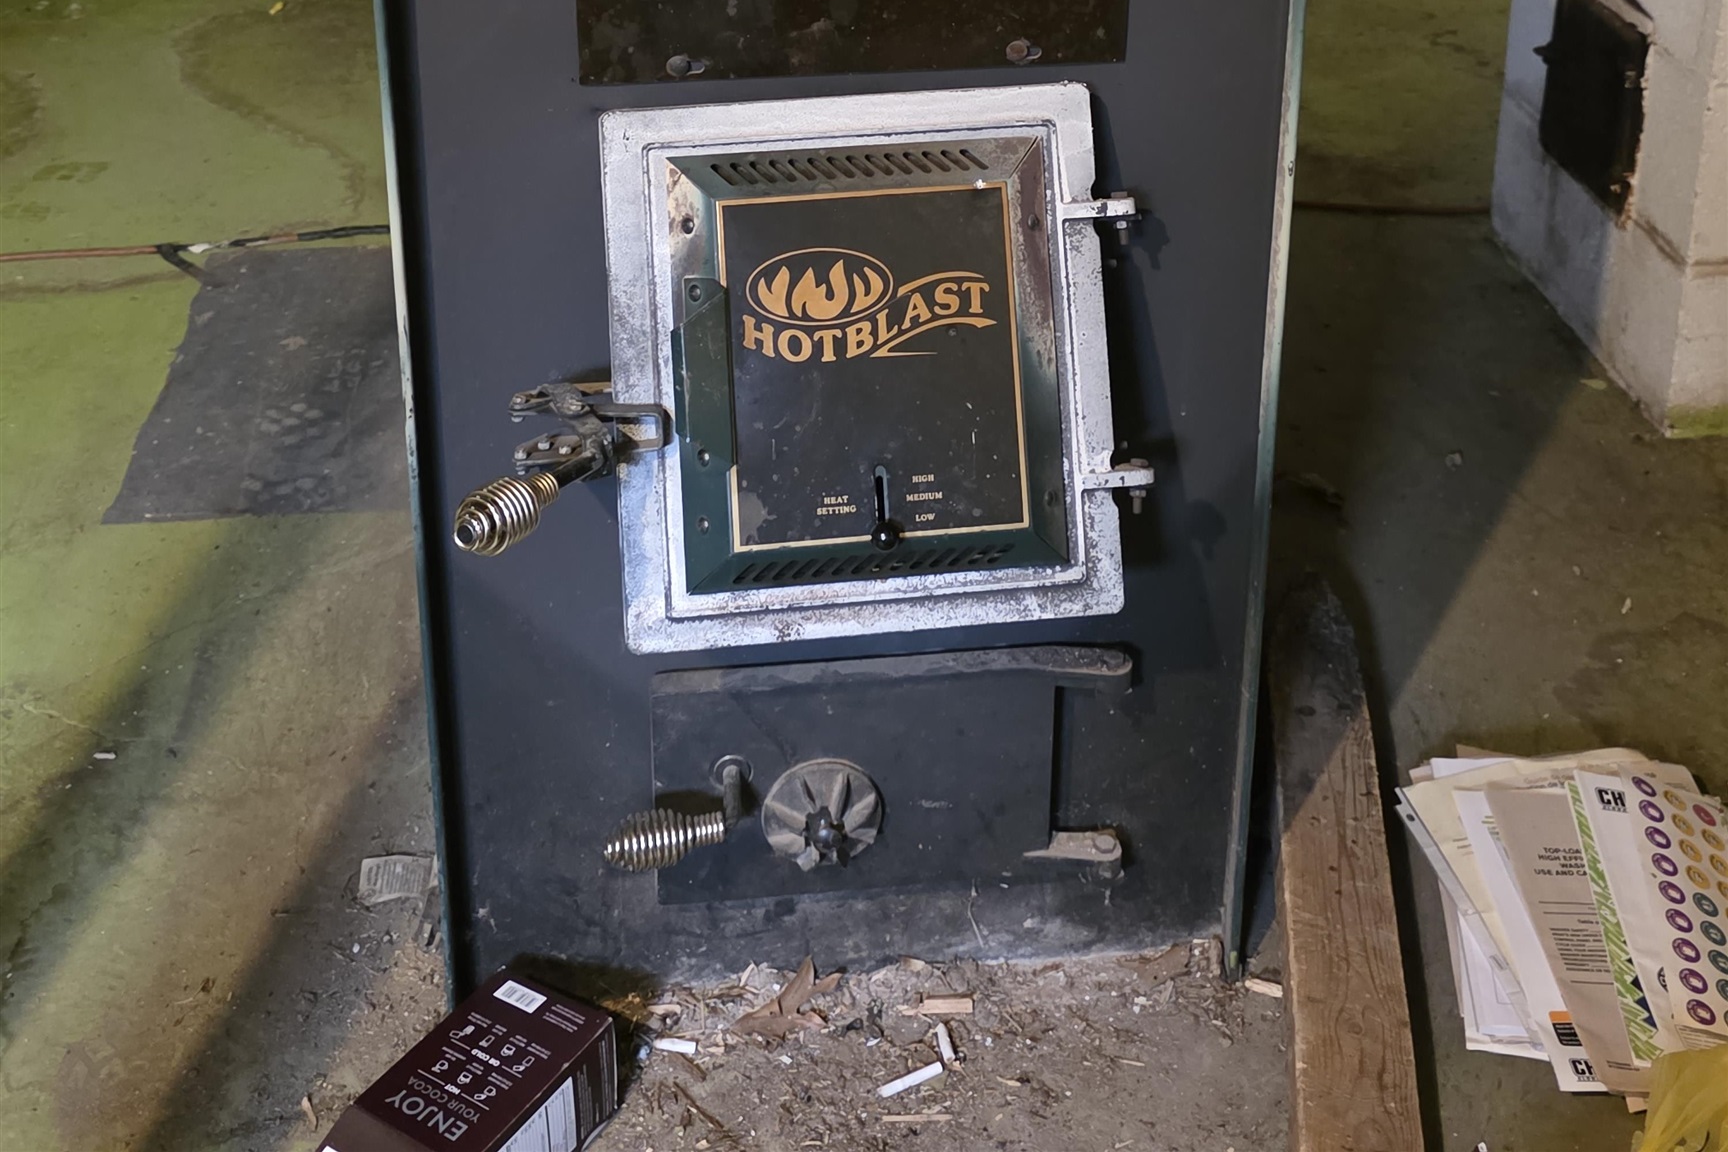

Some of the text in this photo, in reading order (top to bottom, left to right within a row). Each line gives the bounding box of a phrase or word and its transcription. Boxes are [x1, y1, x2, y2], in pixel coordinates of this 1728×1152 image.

[742, 281, 990, 363] HOTBLAST
[912, 474, 935, 483] HIGH
[824, 496, 849, 505] HEAT
[906, 491, 943, 502] MEDIUM
[816, 505, 857, 515] SETTING
[915, 513, 936, 522] LOW
[471, 1048, 490, 1061] COLD
[444, 1084, 461, 1095] HOT
[407, 1076, 480, 1124] YOUR COCOA
[385, 1089, 468, 1141] ENJOY
